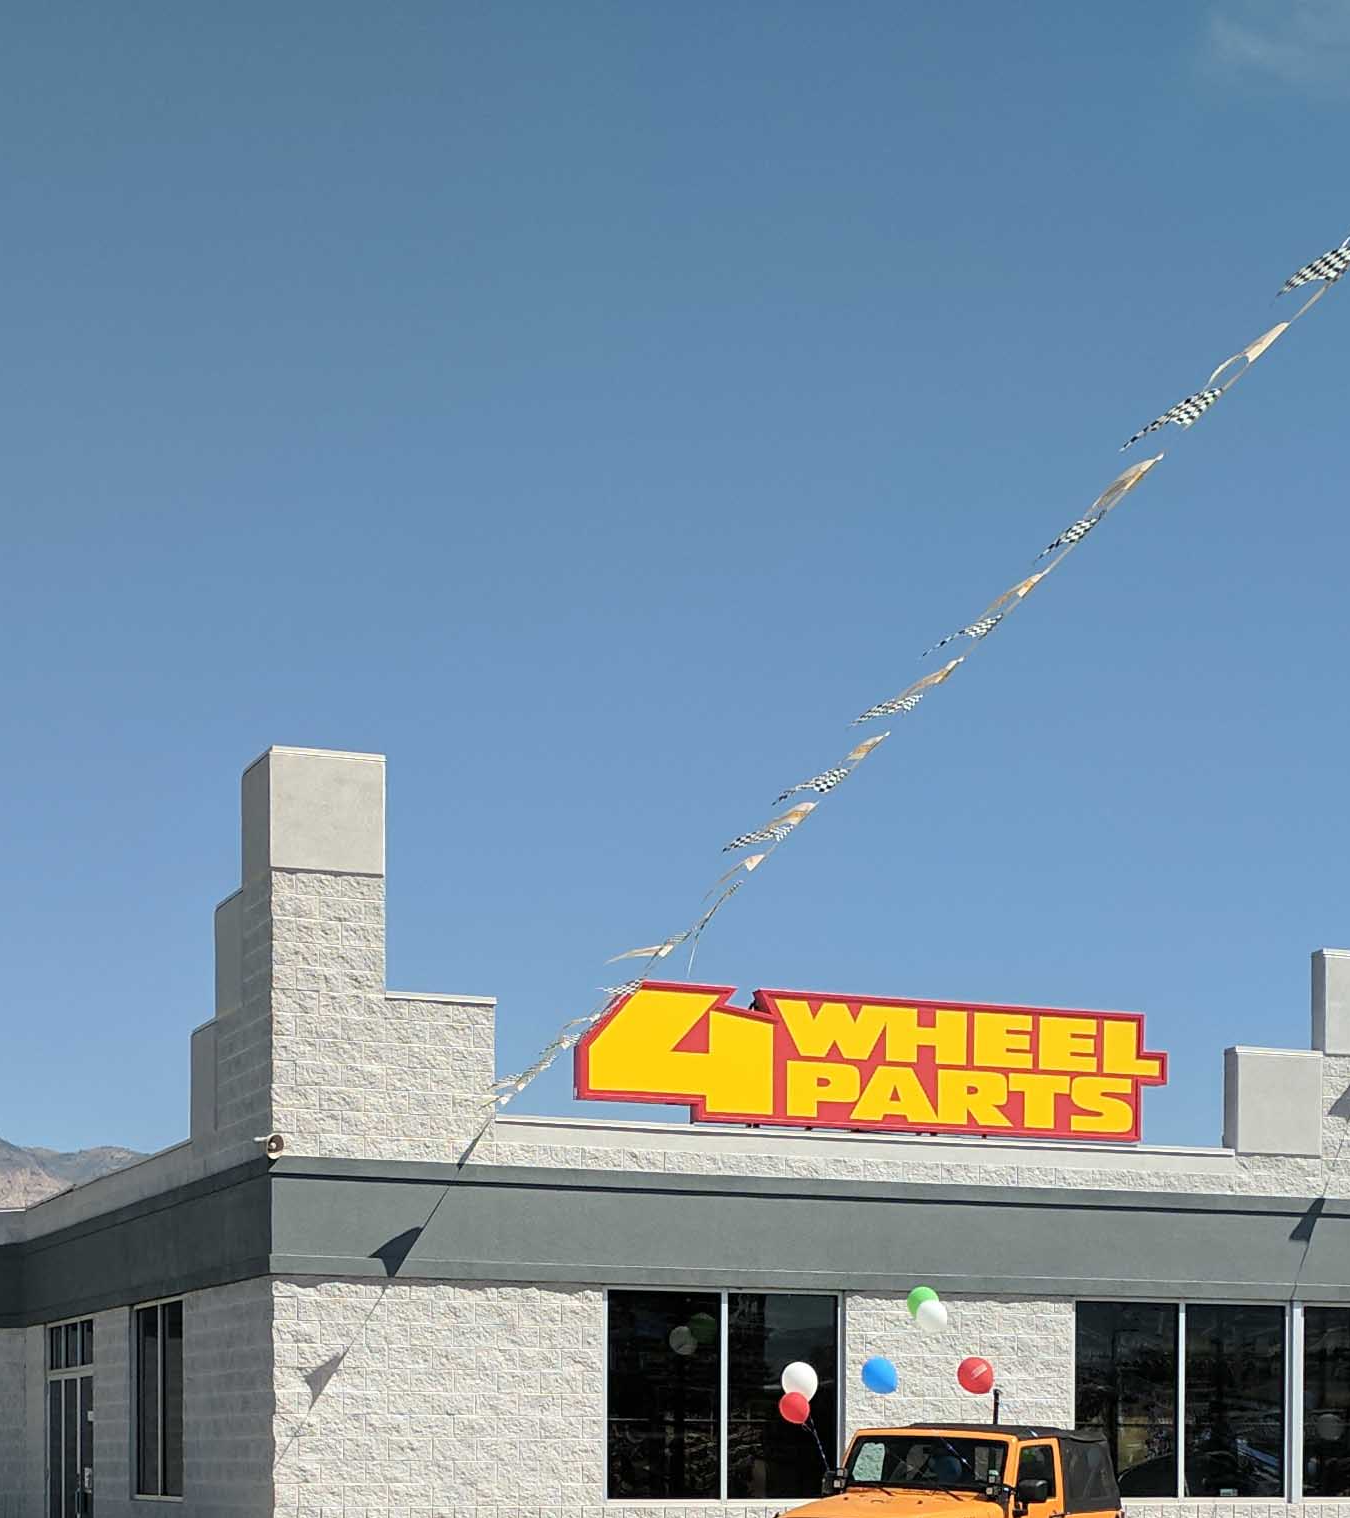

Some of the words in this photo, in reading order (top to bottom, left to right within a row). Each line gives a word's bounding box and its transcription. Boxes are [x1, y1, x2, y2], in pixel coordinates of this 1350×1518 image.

[588, 989, 775, 1116] 4
[776, 998, 1161, 1078] WHEEL
[786, 1059, 1134, 1134] PARTS
